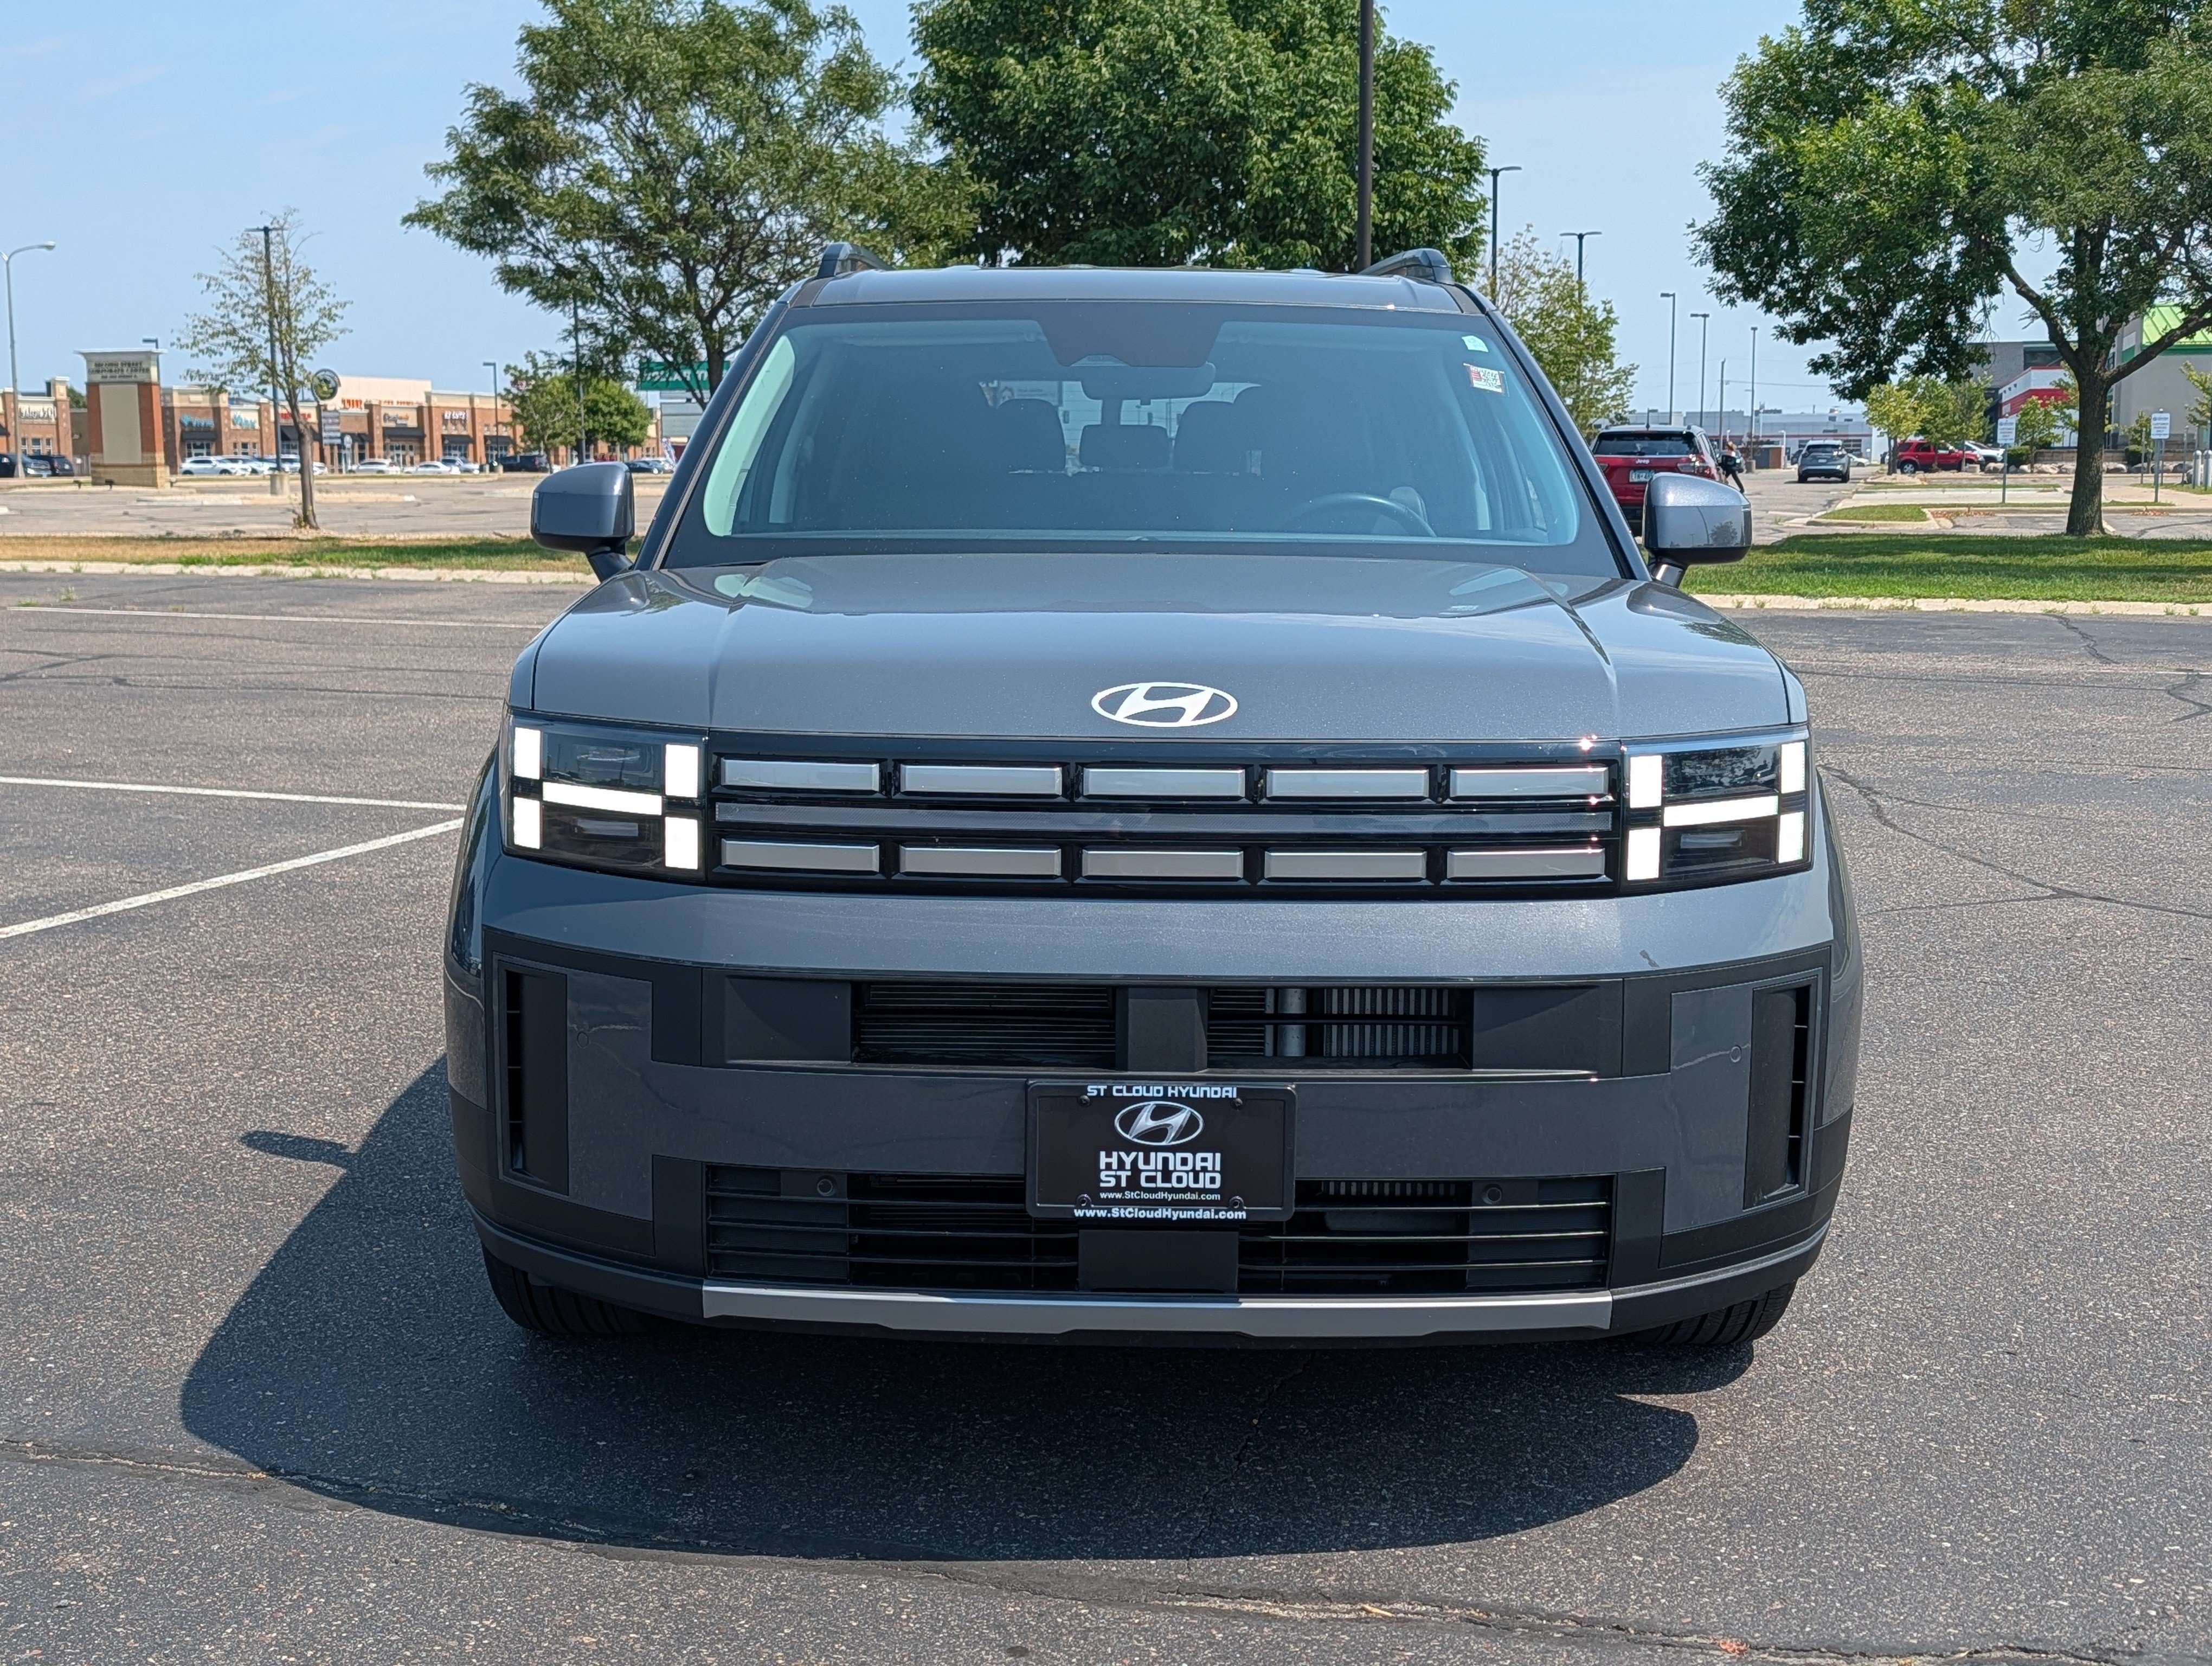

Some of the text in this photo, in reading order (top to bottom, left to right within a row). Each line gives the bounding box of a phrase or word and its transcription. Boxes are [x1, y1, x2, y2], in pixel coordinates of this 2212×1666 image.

[1086, 1085, 1237, 1098] ST CLOUD HYUNDAI
[1099, 1151, 1221, 1171] HYUNDAI
[1099, 1171, 1221, 1189] ST CLOUD
[1099, 1190, 1221, 1201] www.StCloudHyundai.com
[1073, 1207, 1246, 1220] www.StCloudHyundai.com
